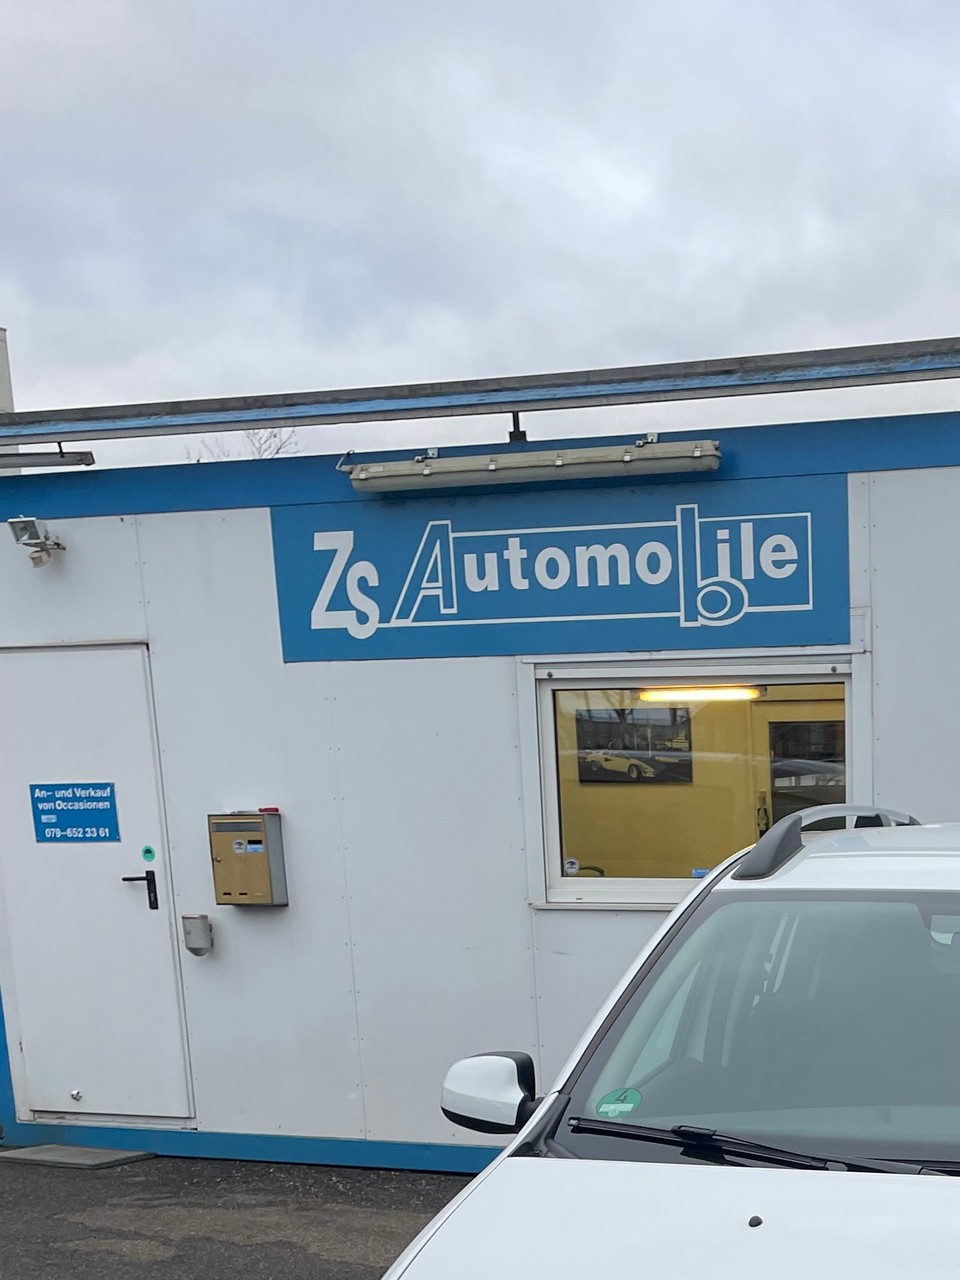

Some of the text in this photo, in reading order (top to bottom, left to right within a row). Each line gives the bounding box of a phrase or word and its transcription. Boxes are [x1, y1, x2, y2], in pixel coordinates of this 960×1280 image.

[389, 504, 799, 627] Automobile
[34, 787, 111, 798] An- und Verkauf
[37, 799, 110, 810] von Occasionen
[85, 827, 97, 838] 33
[98, 827, 110, 838] 61
[614, 1089, 629, 1104] 4
